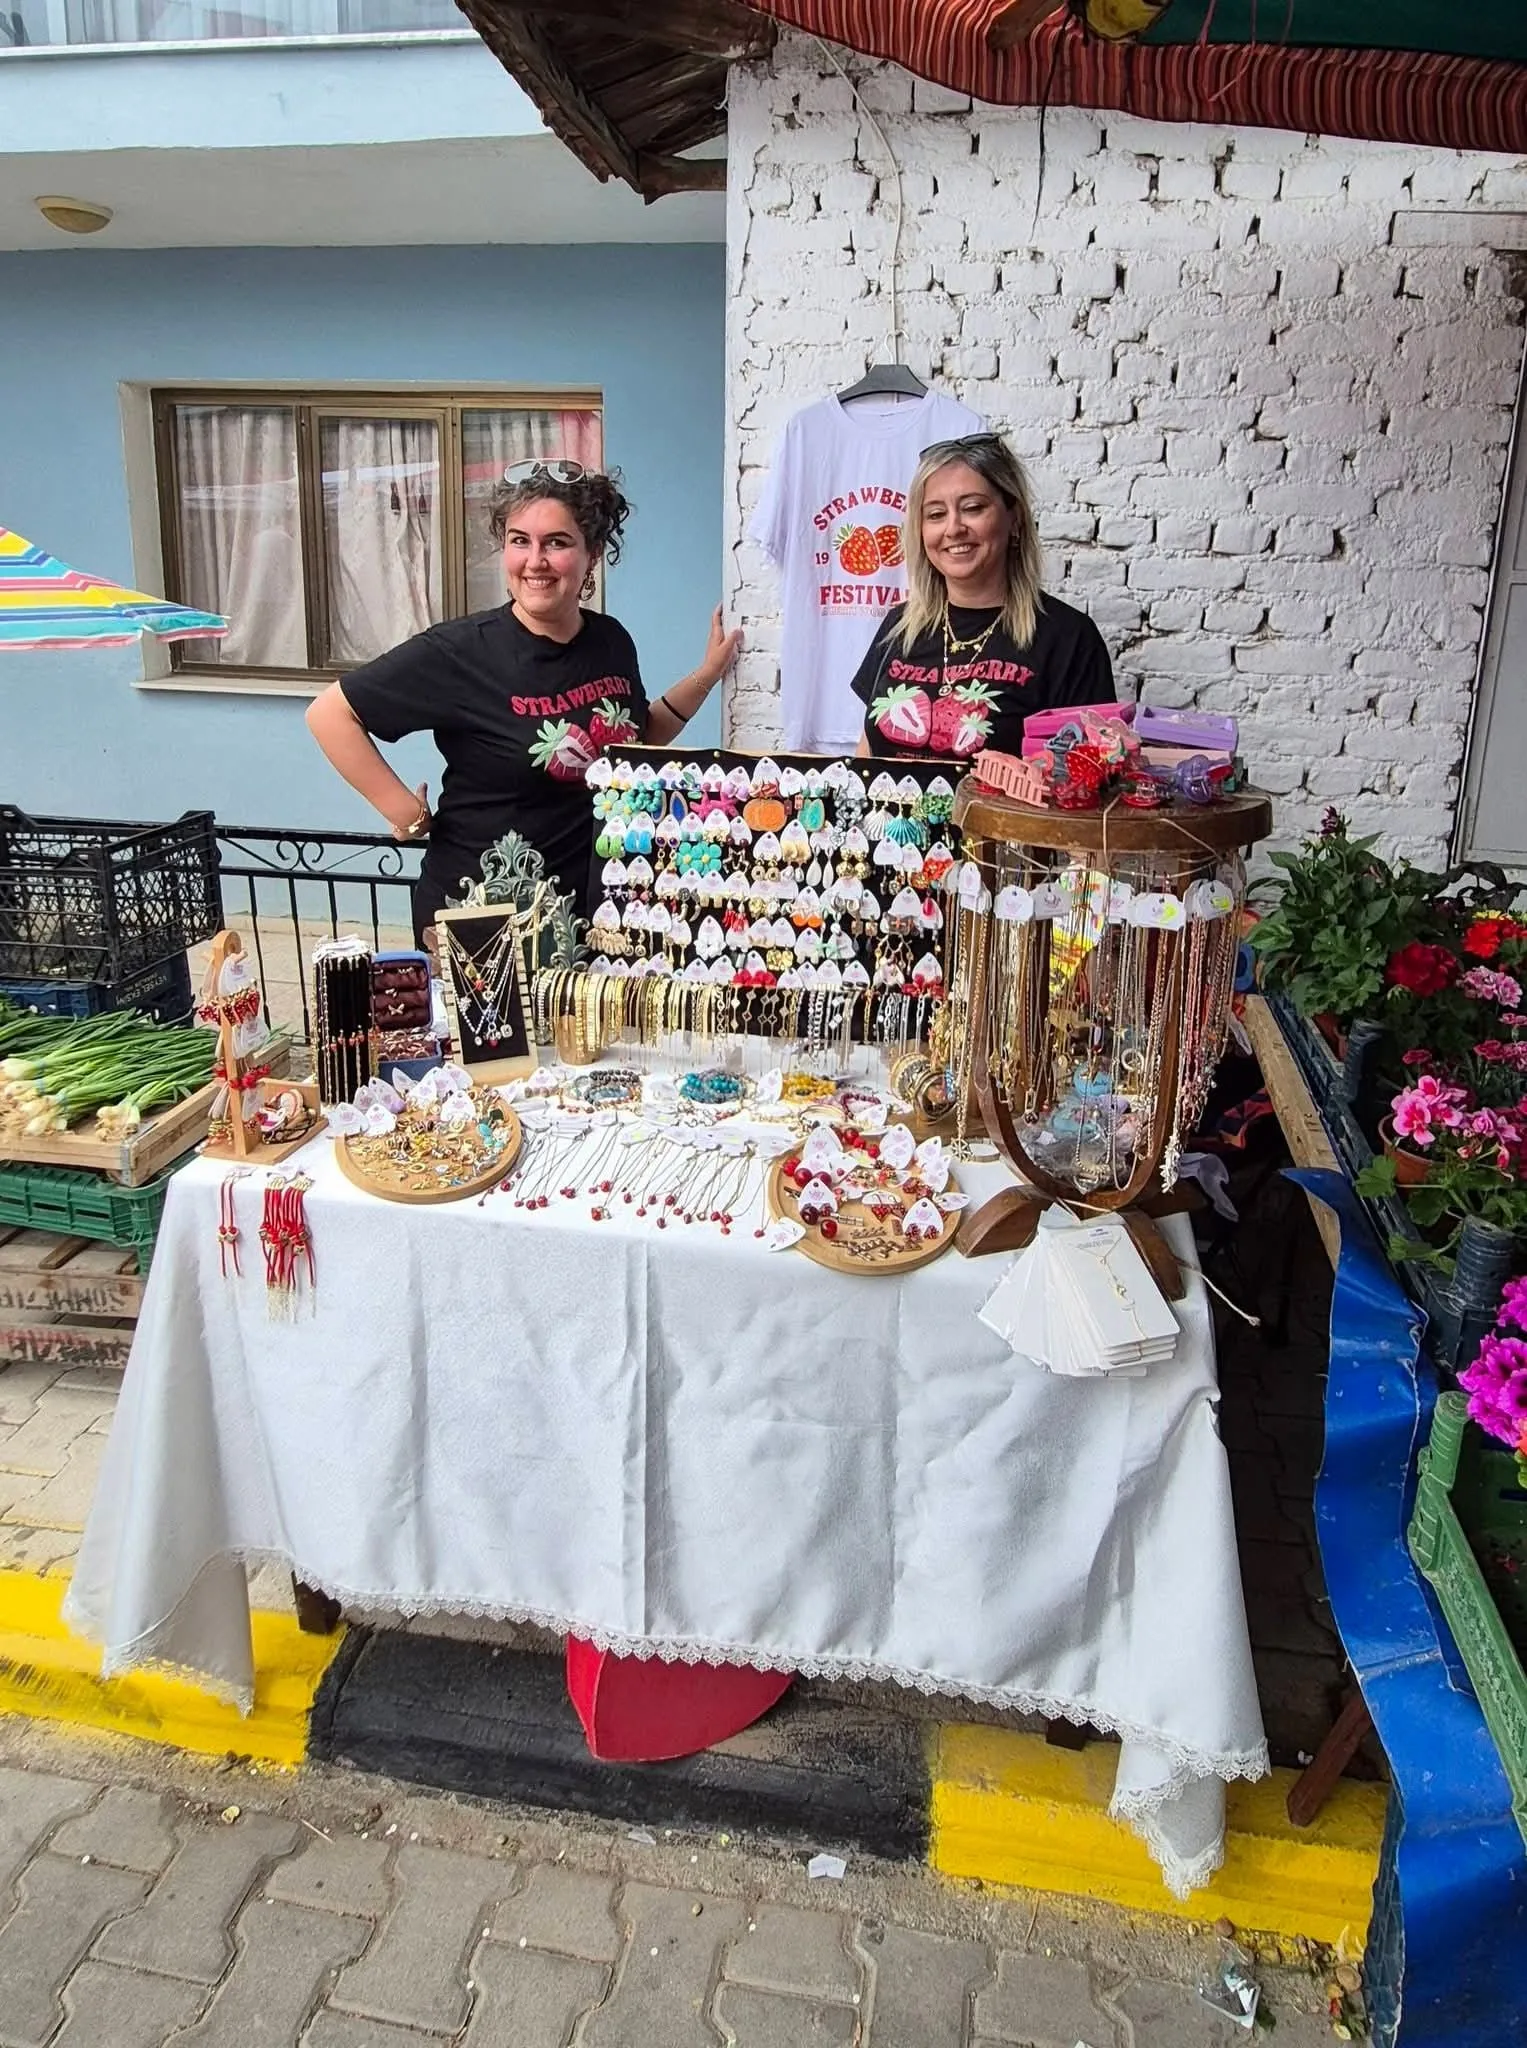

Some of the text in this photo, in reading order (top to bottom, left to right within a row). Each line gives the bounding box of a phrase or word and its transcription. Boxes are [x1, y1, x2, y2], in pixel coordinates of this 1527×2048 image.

[814, 486, 908, 531] STRAWBE
[815, 552, 830, 565] 19
[820, 585, 909, 606] FESTIVA
[511, 675, 632, 716] STRAWBERRY
